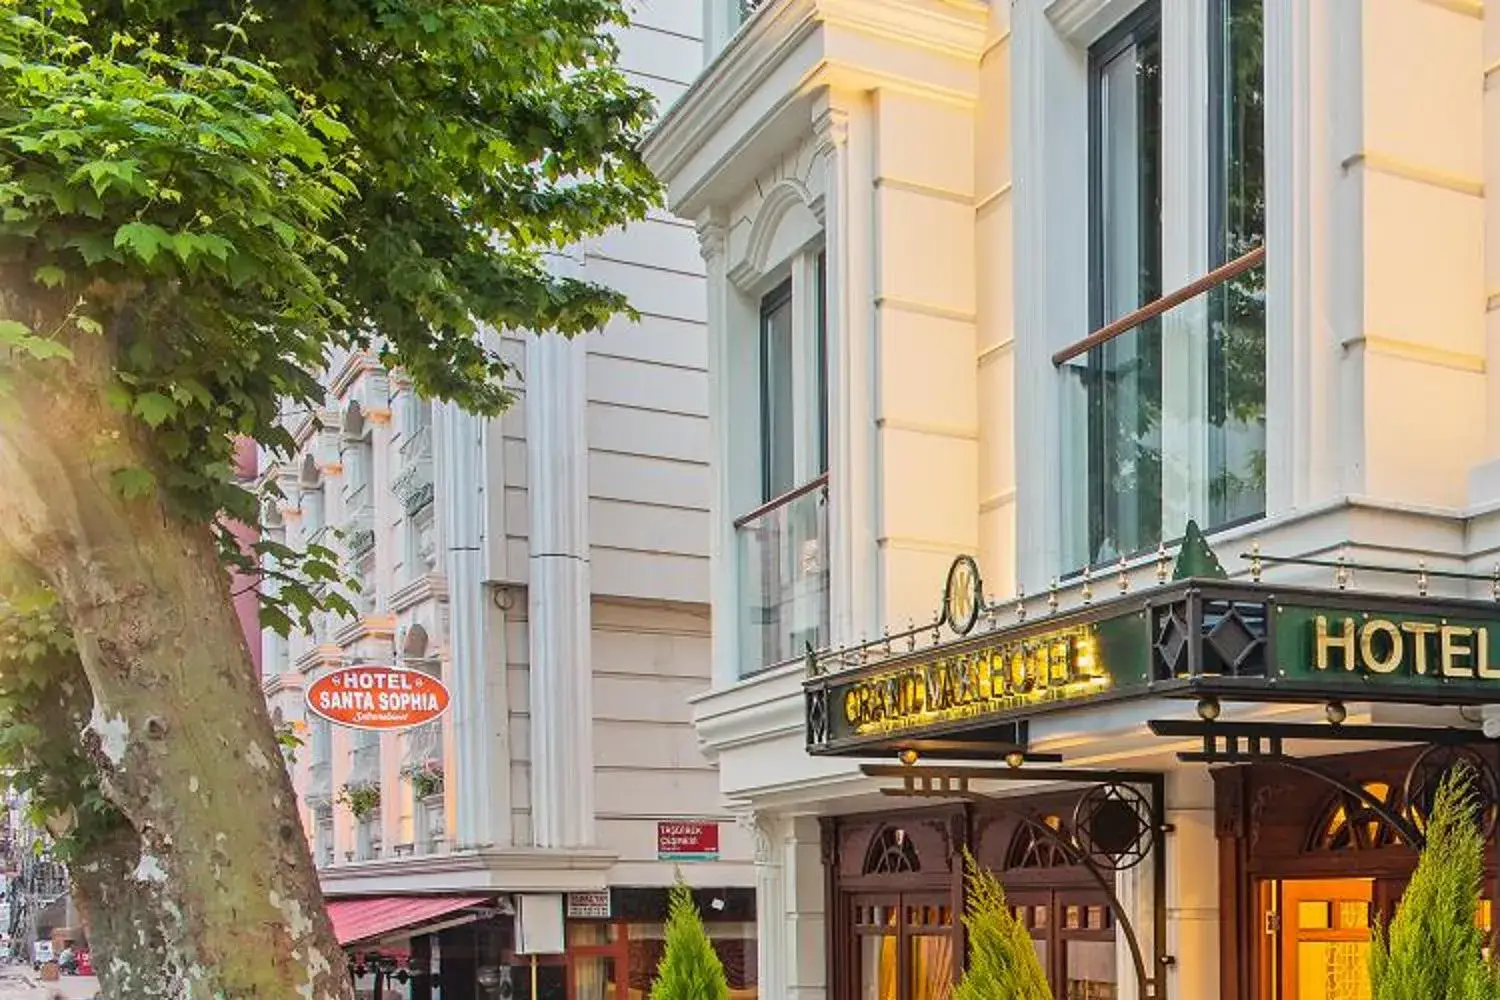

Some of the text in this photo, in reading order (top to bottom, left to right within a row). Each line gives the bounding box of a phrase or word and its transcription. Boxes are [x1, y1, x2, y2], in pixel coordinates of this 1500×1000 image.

[343, 672, 412, 689] HOTEL
[844, 668, 926, 724] GRAND
[991, 633, 1108, 699] HOTEL
[320, 691, 439, 711] SANTA SOPHIA
